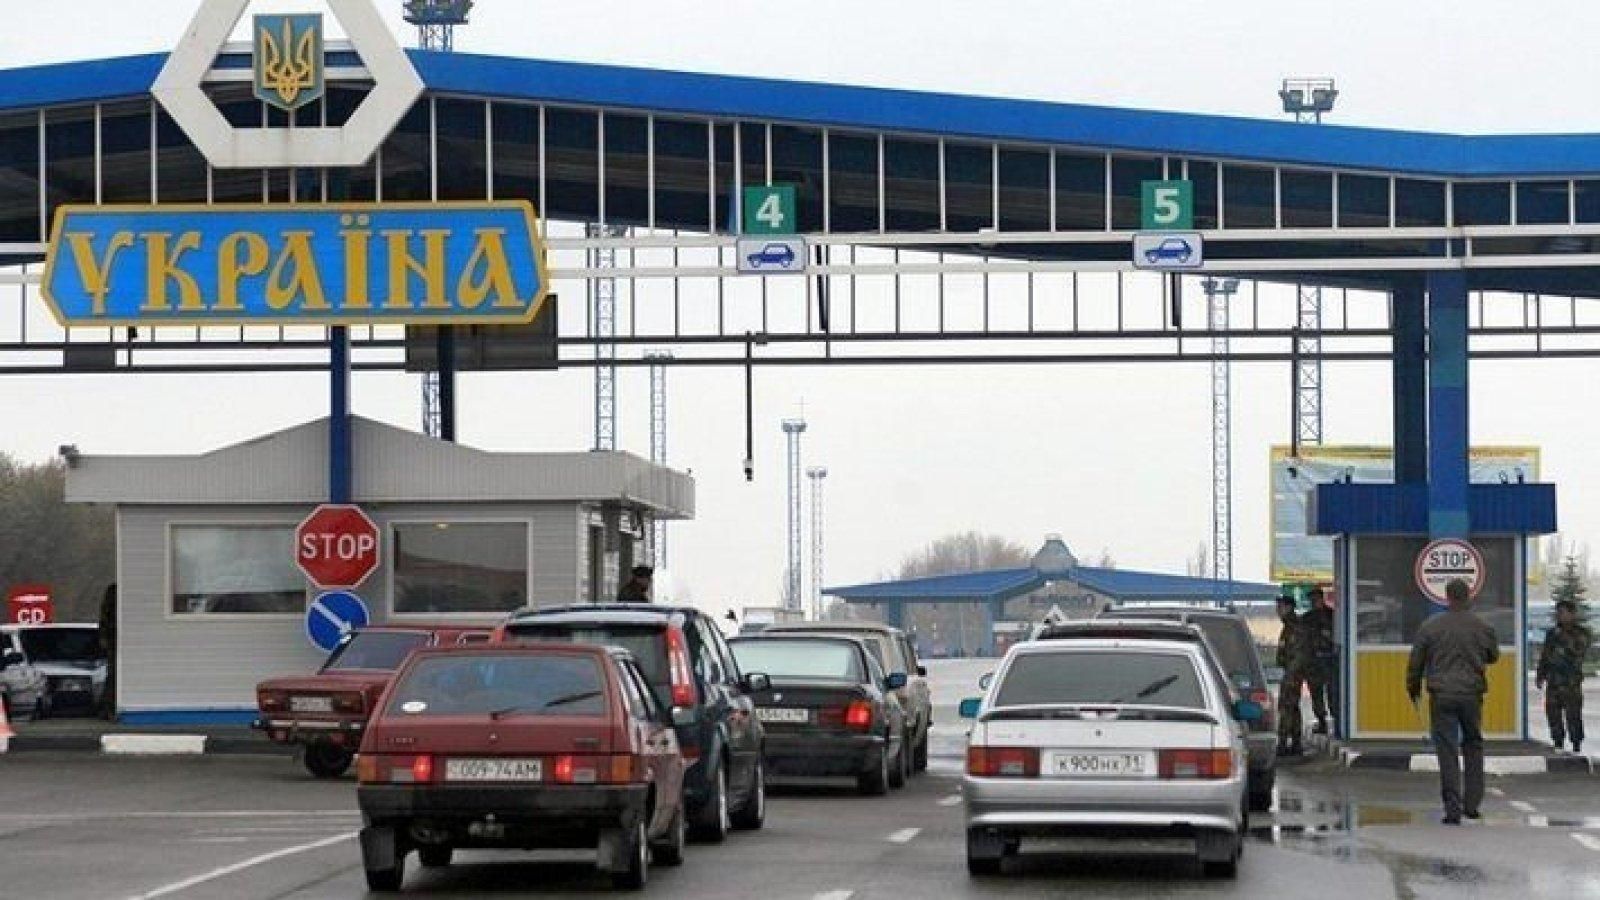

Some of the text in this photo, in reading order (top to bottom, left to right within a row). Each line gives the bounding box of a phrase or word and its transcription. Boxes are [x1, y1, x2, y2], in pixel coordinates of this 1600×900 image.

[756, 194, 784, 228] 4
[1154, 188, 1180, 224] 5
[65, 214, 526, 314] УКРАЇНА
[302, 532, 375, 560] STOP
[1429, 550, 1470, 568] STOP
[17, 607, 46, 626] CD
